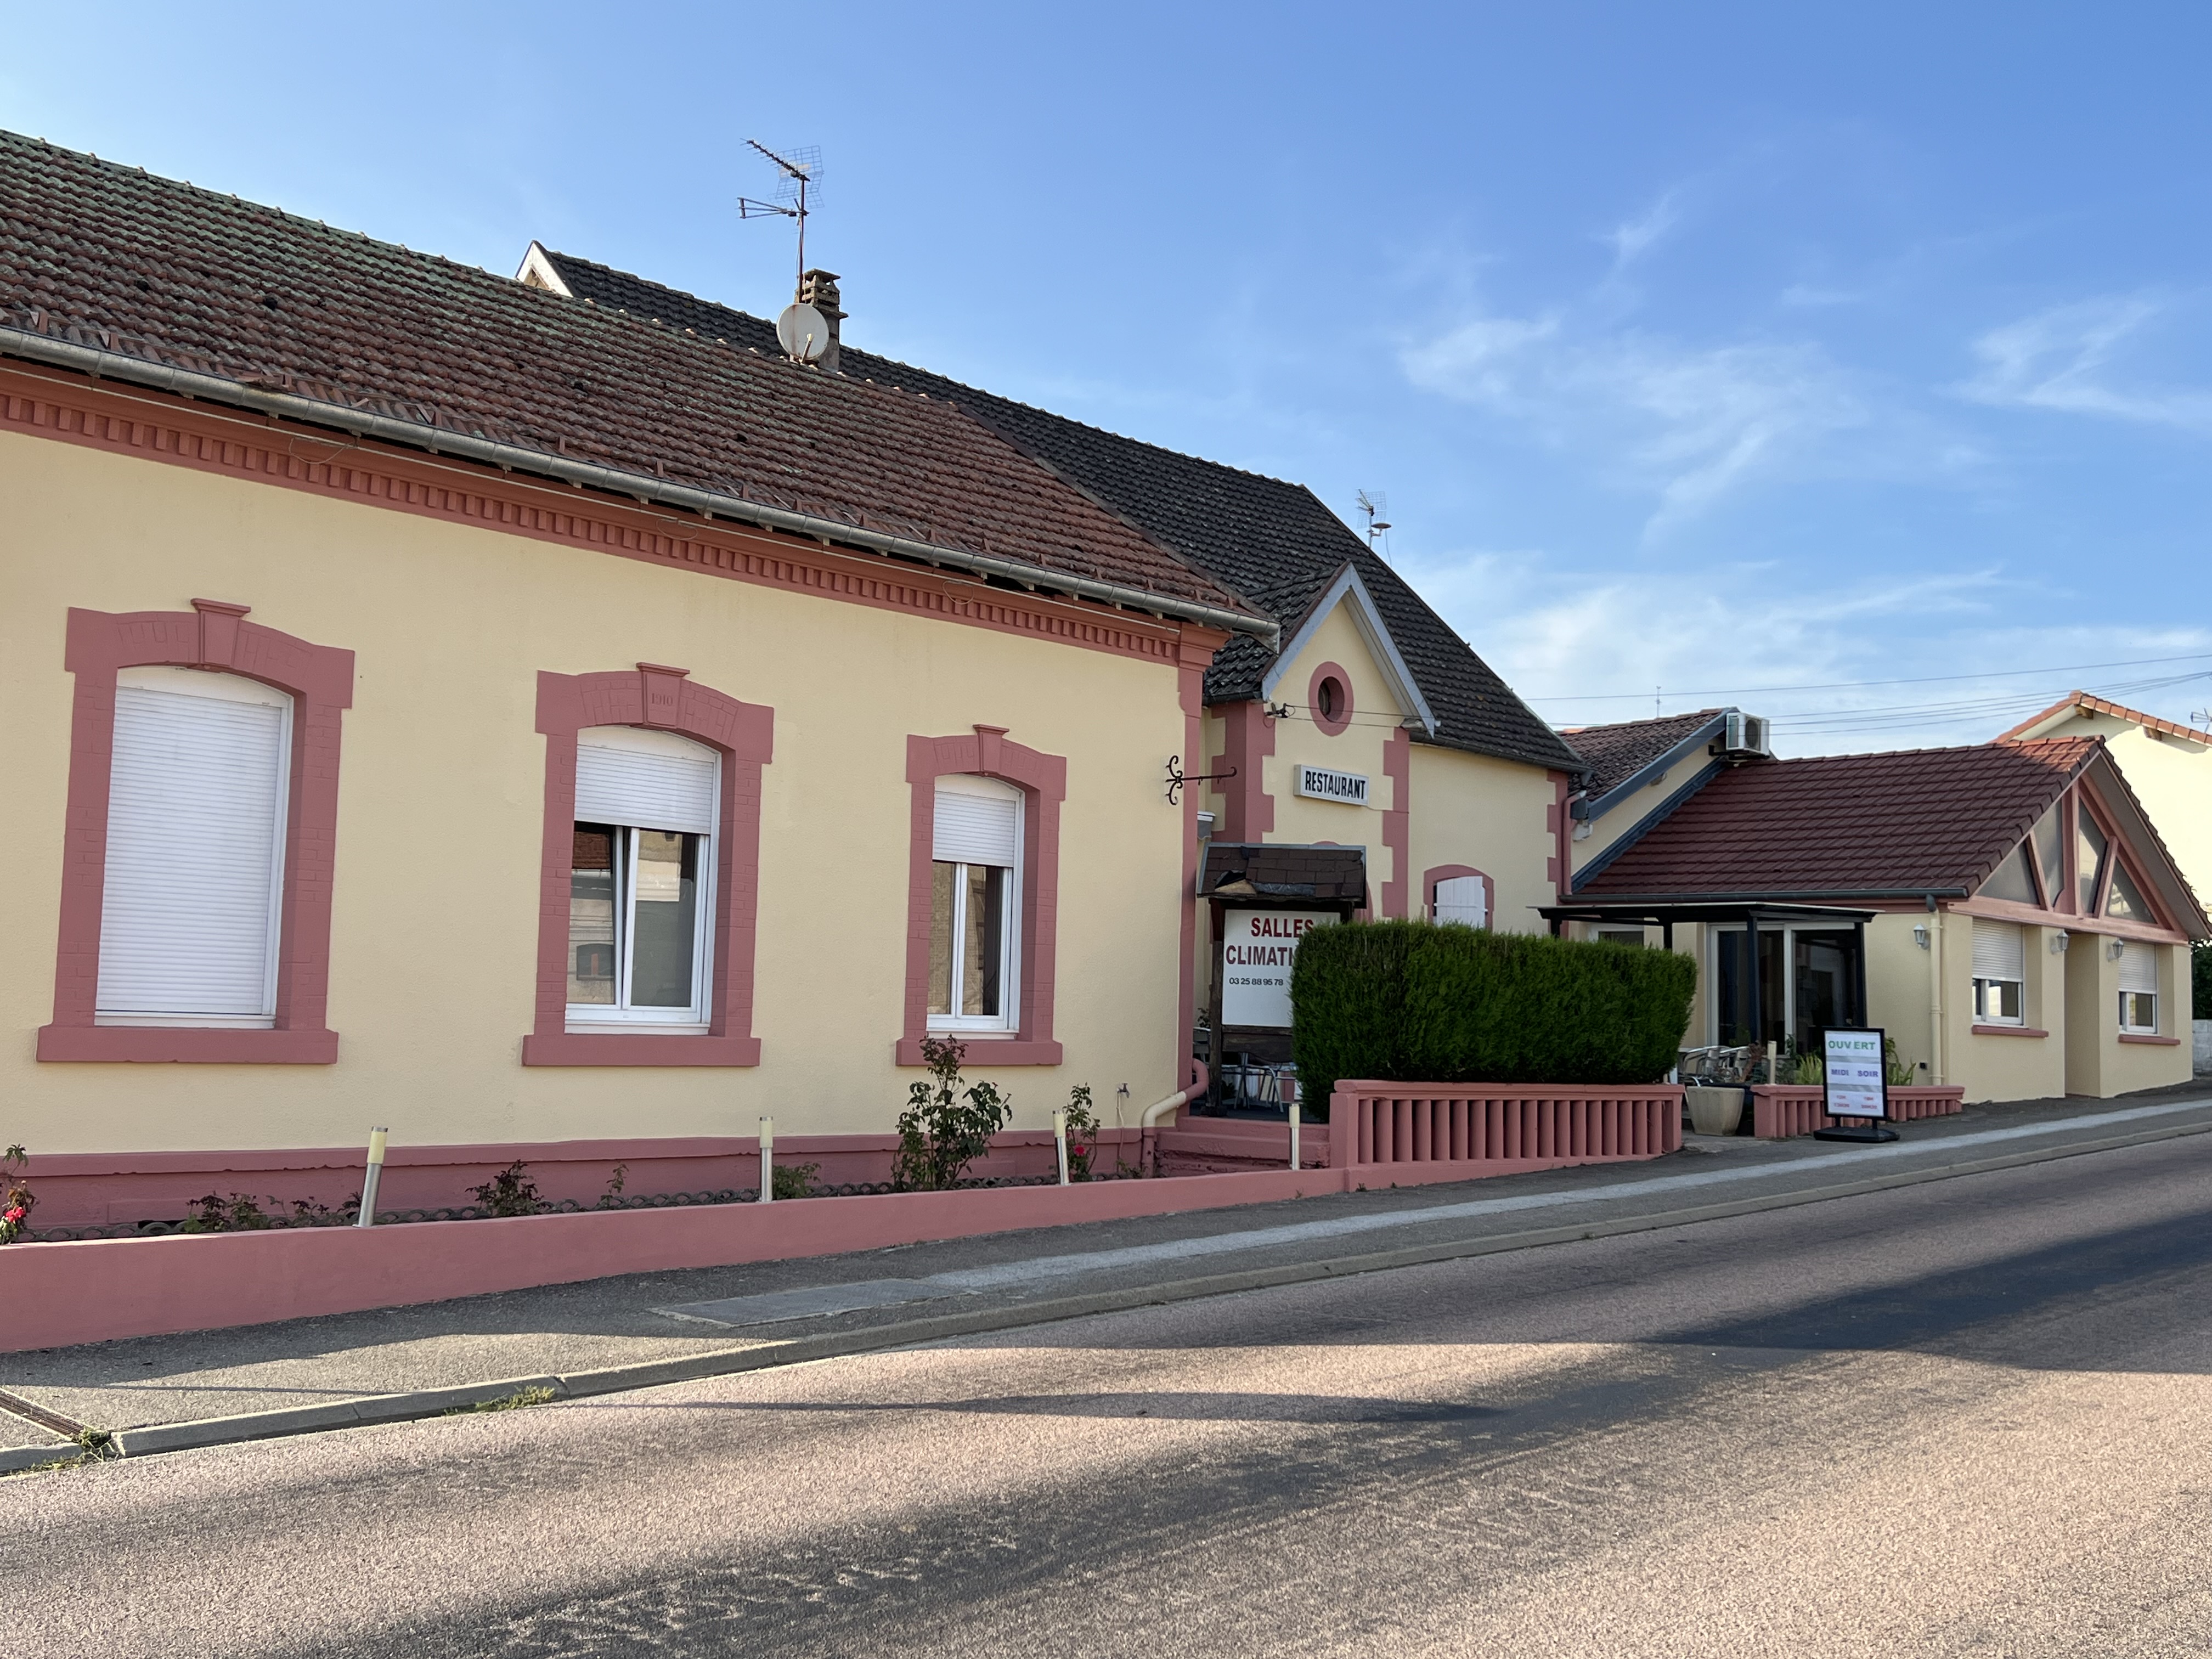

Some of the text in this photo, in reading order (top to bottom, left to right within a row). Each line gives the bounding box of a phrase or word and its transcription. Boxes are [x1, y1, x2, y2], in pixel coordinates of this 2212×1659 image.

[1305, 770, 1365, 799] RESTAURANT
[1251, 917, 1313, 938] SALLES
[1226, 945, 1293, 966] CLIMATI
[1828, 1041, 1876, 1050] OUVERT
